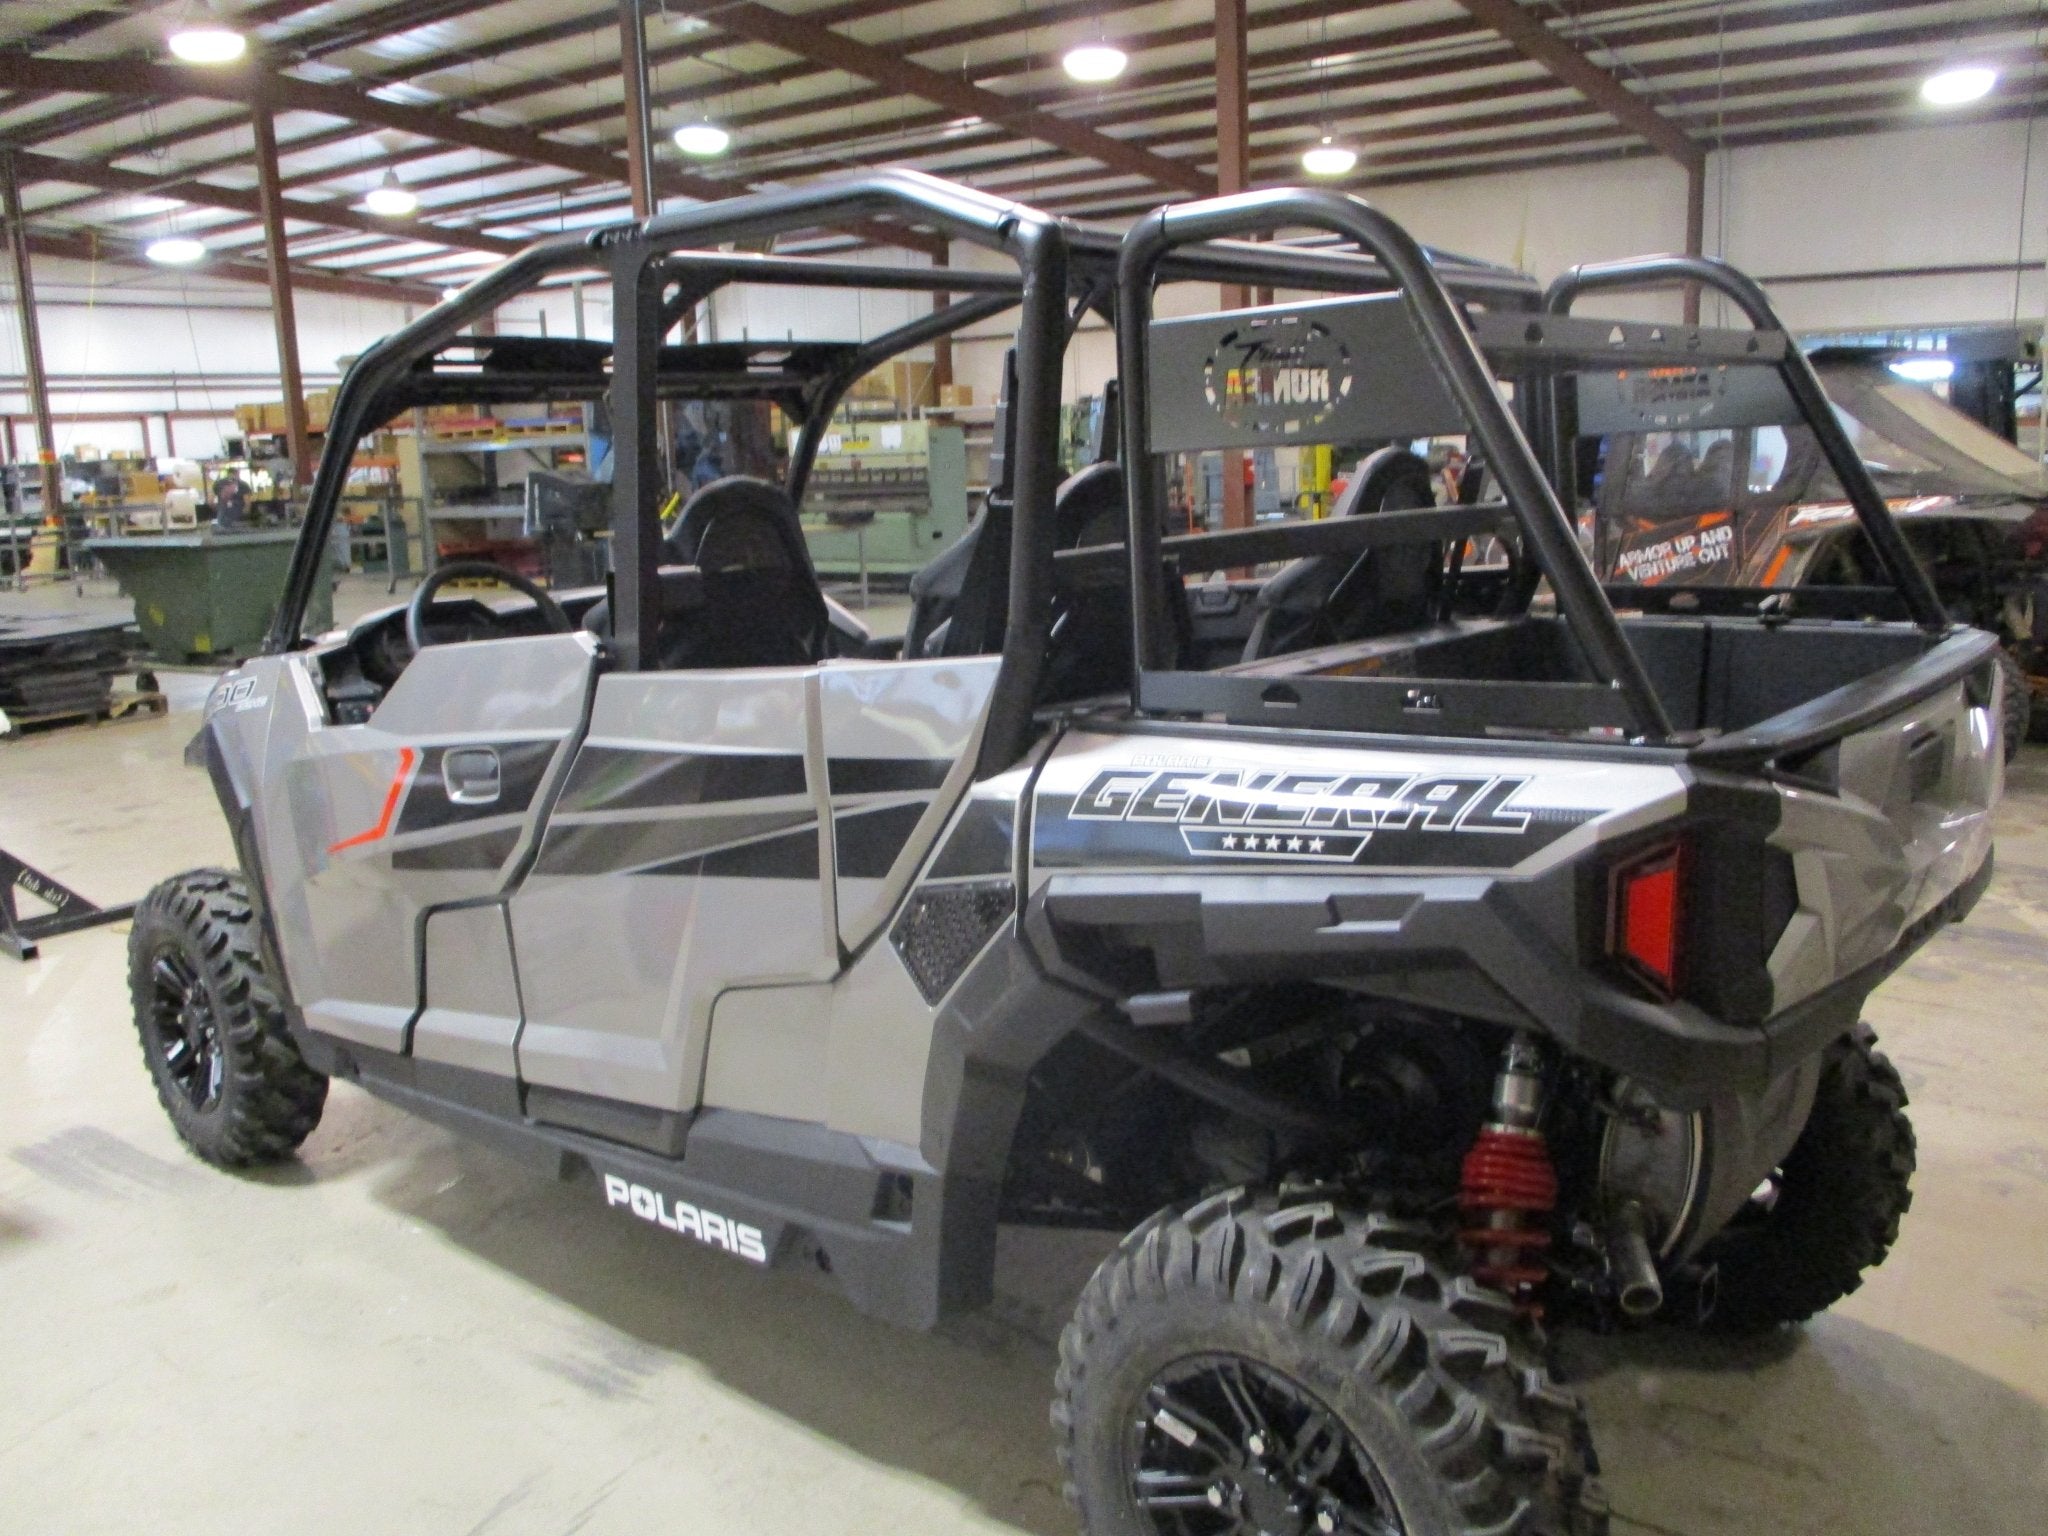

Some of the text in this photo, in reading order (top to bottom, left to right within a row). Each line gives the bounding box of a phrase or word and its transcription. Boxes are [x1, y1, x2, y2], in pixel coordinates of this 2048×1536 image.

[1618, 525, 1734, 569] ARMOR UP AND
[1626, 544, 1730, 581] VENTURE OUT
[1068, 766, 1535, 834] GENERAL
[604, 1172, 767, 1264] POLARIS
